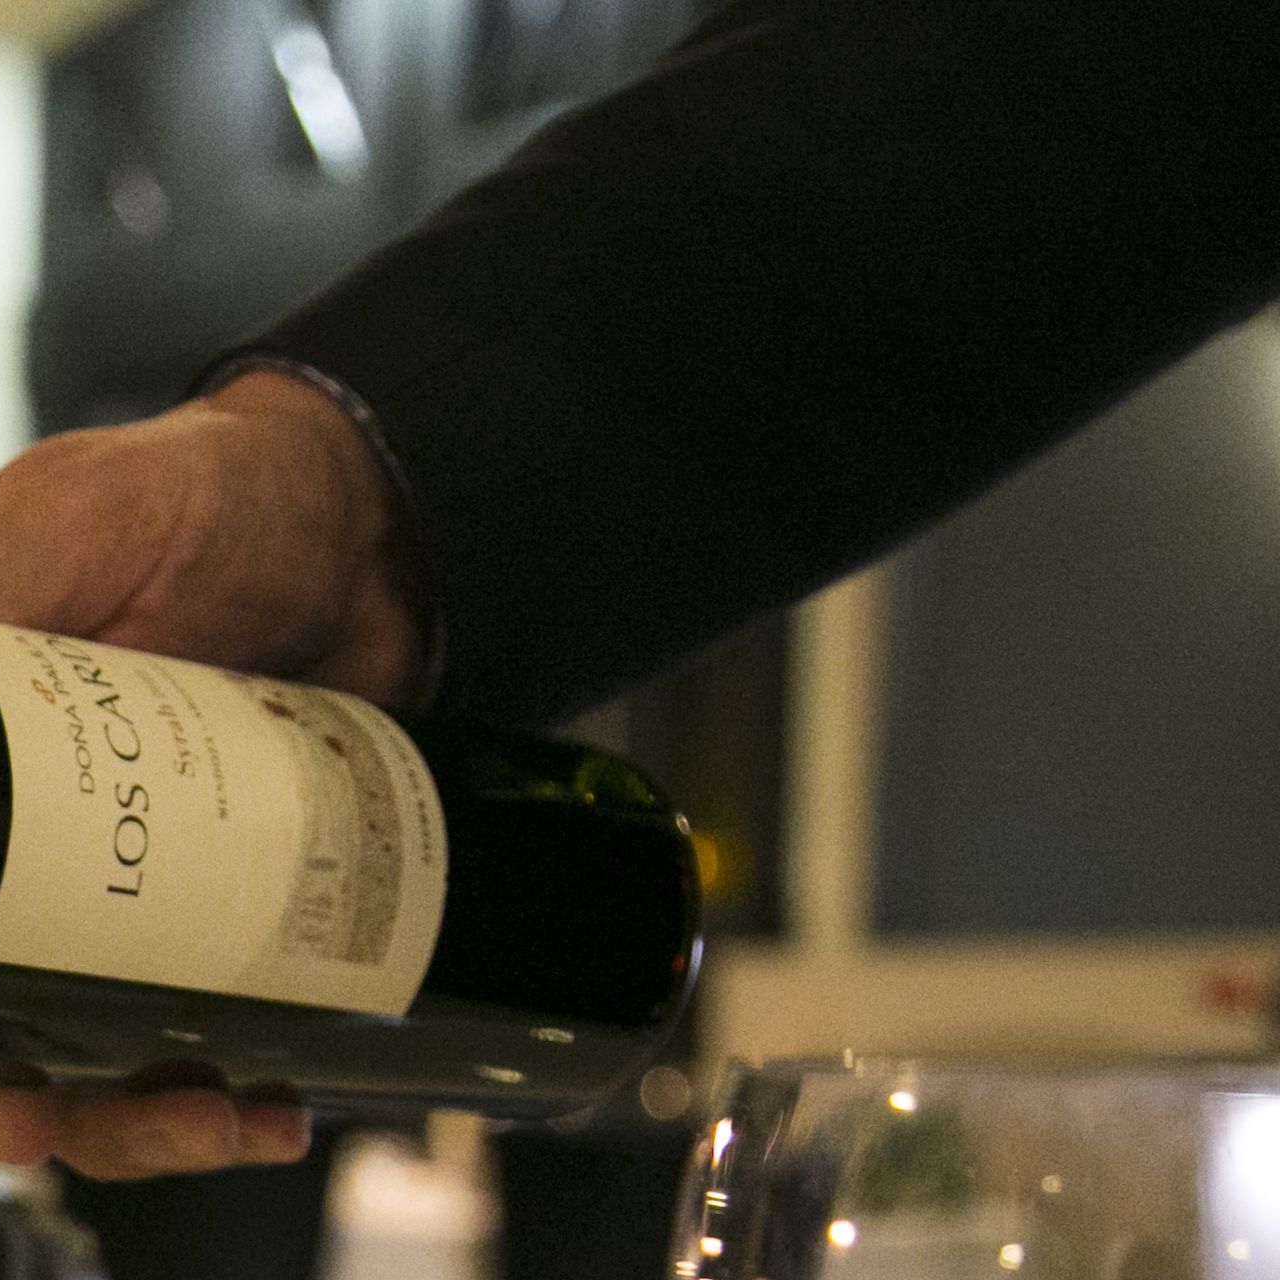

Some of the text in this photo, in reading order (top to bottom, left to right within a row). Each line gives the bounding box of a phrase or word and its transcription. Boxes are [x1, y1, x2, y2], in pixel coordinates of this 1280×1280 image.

[46, 638, 150, 897] LOS CARD
[156, 704, 200, 777] Syrah
